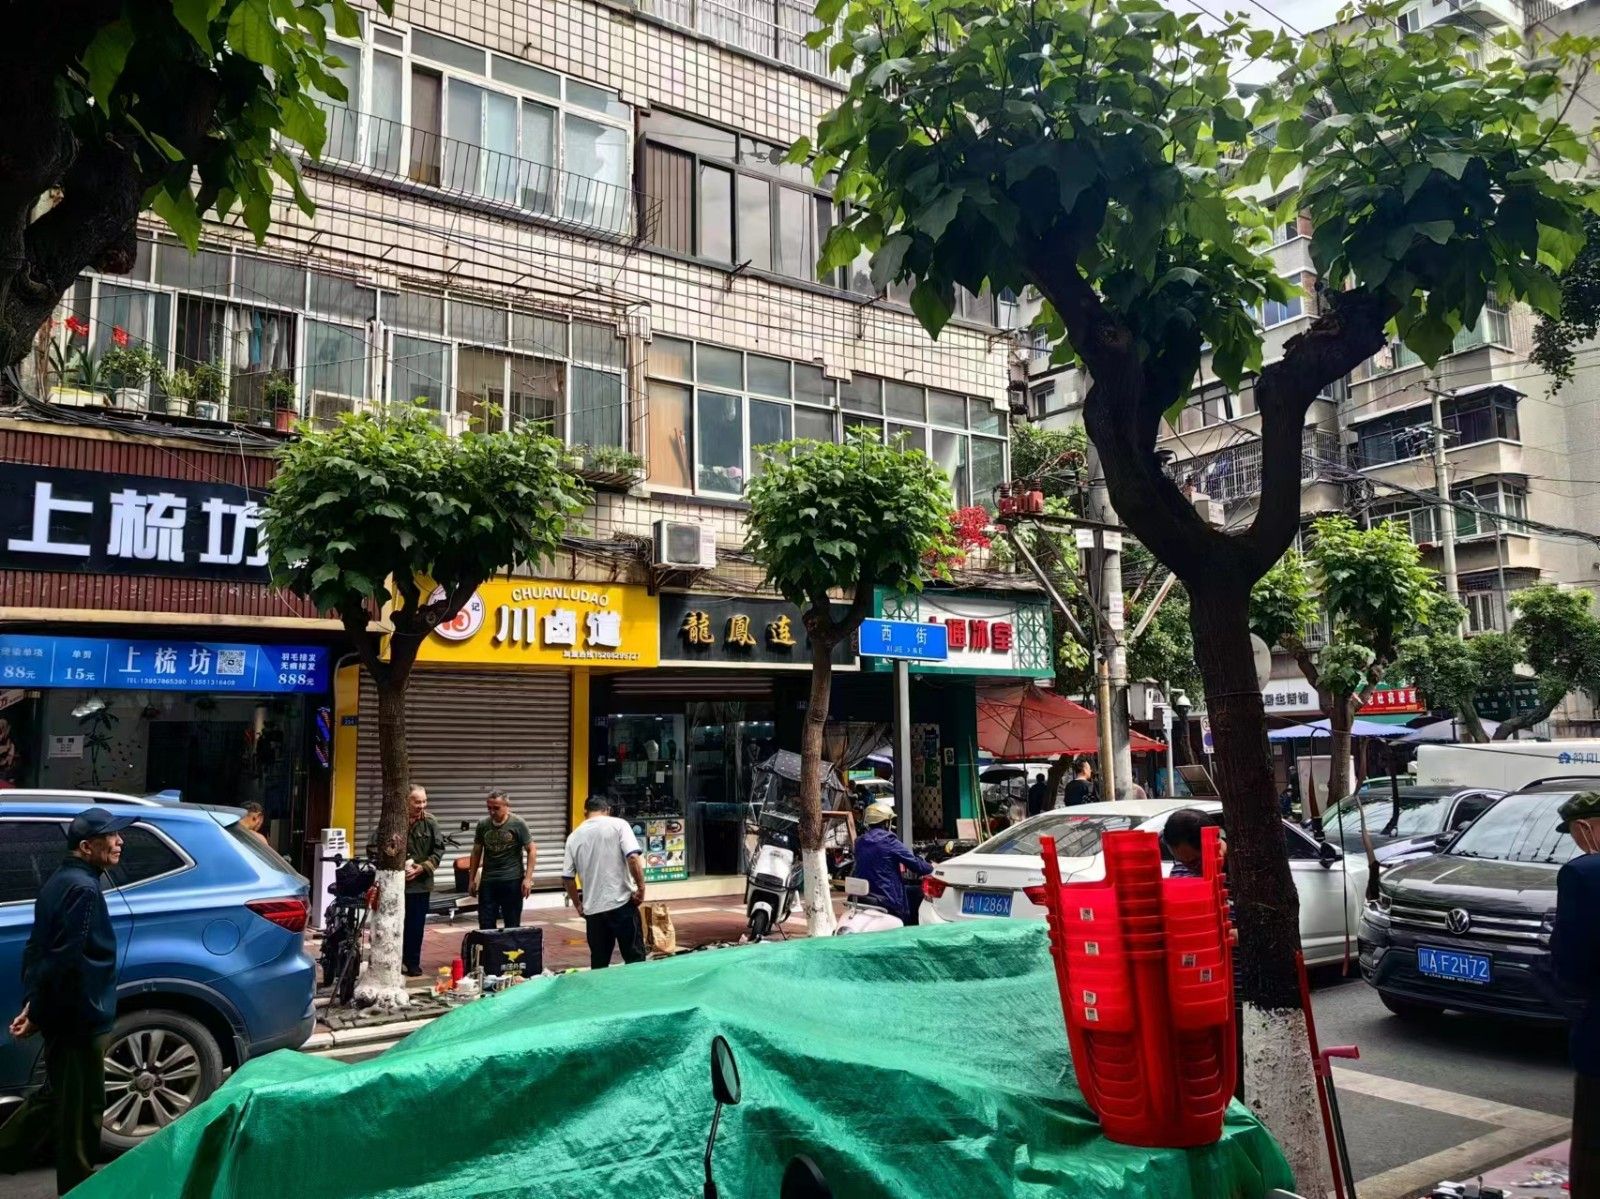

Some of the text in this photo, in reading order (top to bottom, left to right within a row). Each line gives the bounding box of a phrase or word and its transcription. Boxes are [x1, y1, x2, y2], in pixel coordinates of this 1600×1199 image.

[8, 481, 270, 566] 上梳坊
[511, 586, 610, 606] CHUANLUDAO
[495, 604, 621, 647] 川卤道
[929, 616, 1013, 651] 通冰室
[881, 624, 927, 645] 西街
[72, 649, 92, 659] 单剪
[119, 646, 211, 675] 上梳坊
[281, 652, 316, 662] 羽毛接发
[3, 665, 36, 679] 88元
[64, 667, 95, 681] 15元
[280, 661, 316, 671] 无痕接发
[278, 672, 315, 686] 888元
